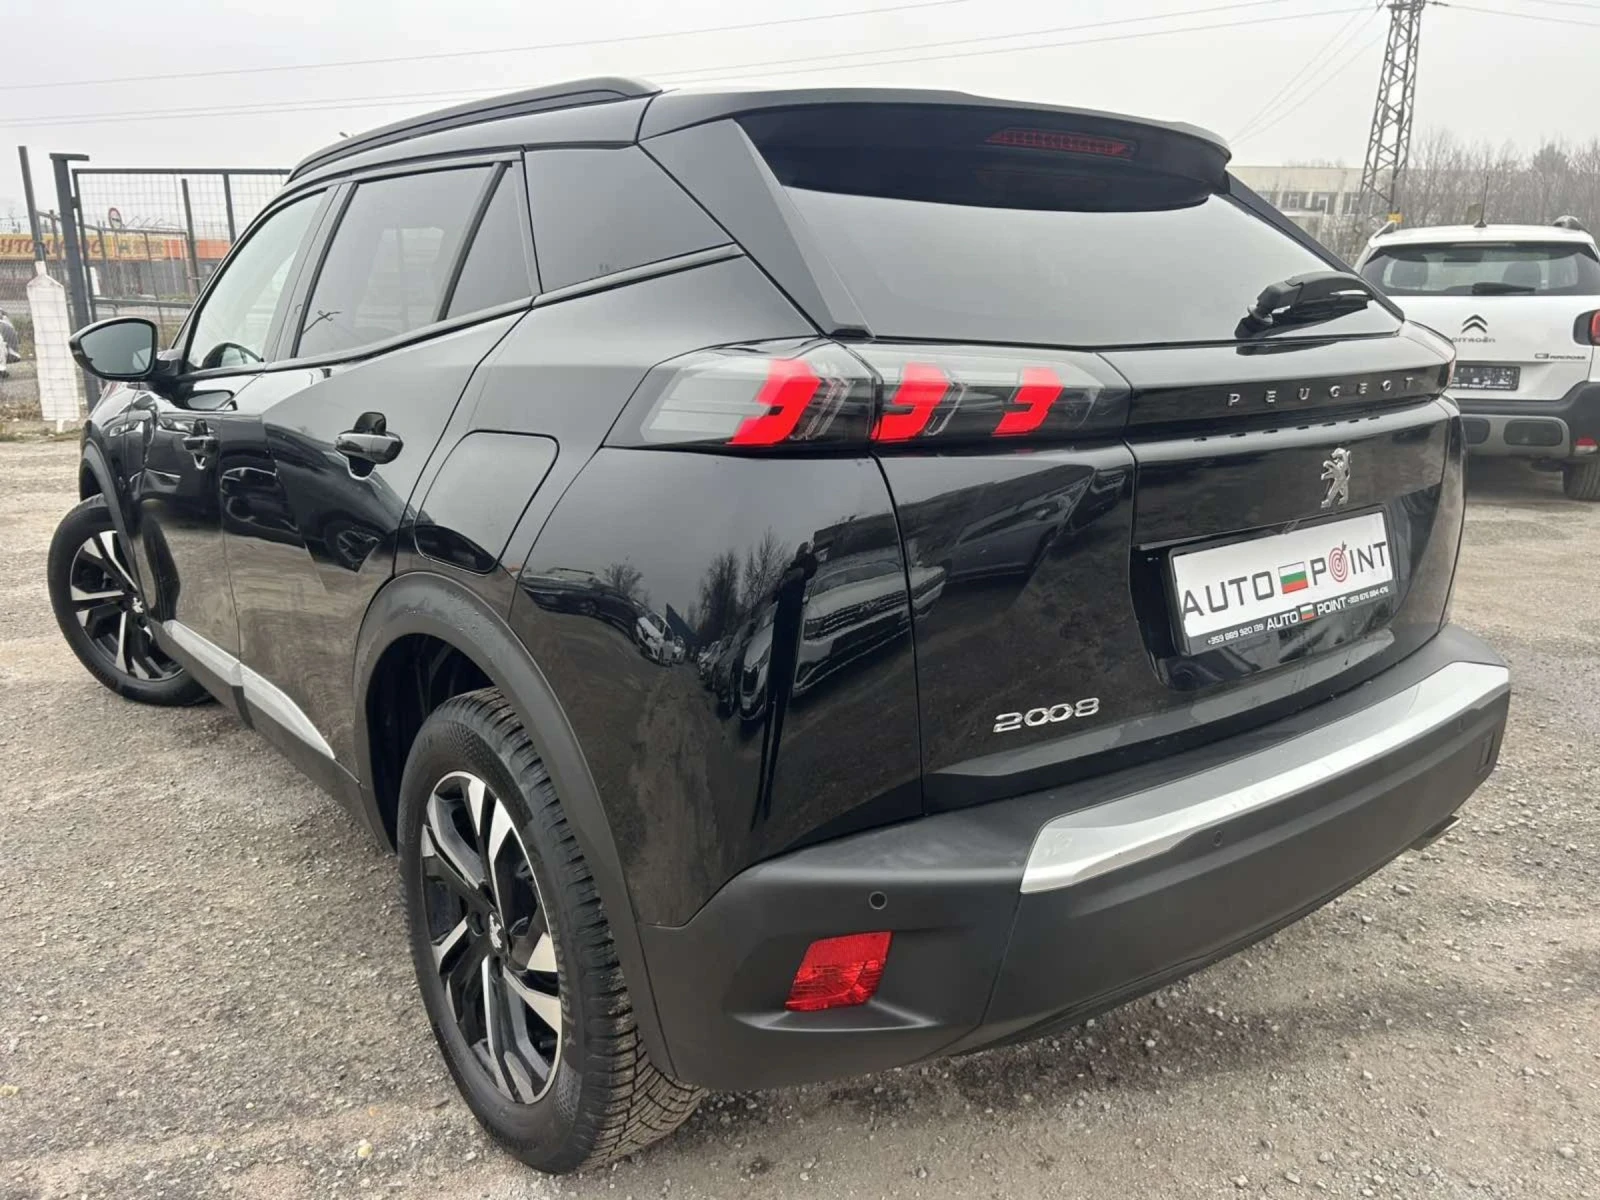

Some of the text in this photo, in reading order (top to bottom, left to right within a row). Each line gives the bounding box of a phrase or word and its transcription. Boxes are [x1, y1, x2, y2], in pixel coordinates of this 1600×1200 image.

[1227, 377, 1414, 406] PEUGEOT
[1181, 571, 1275, 620] AUTO
[1266, 611, 1299, 631] AUTO
[1316, 596, 1347, 616] POINT
[993, 697, 1100, 733] 2008
